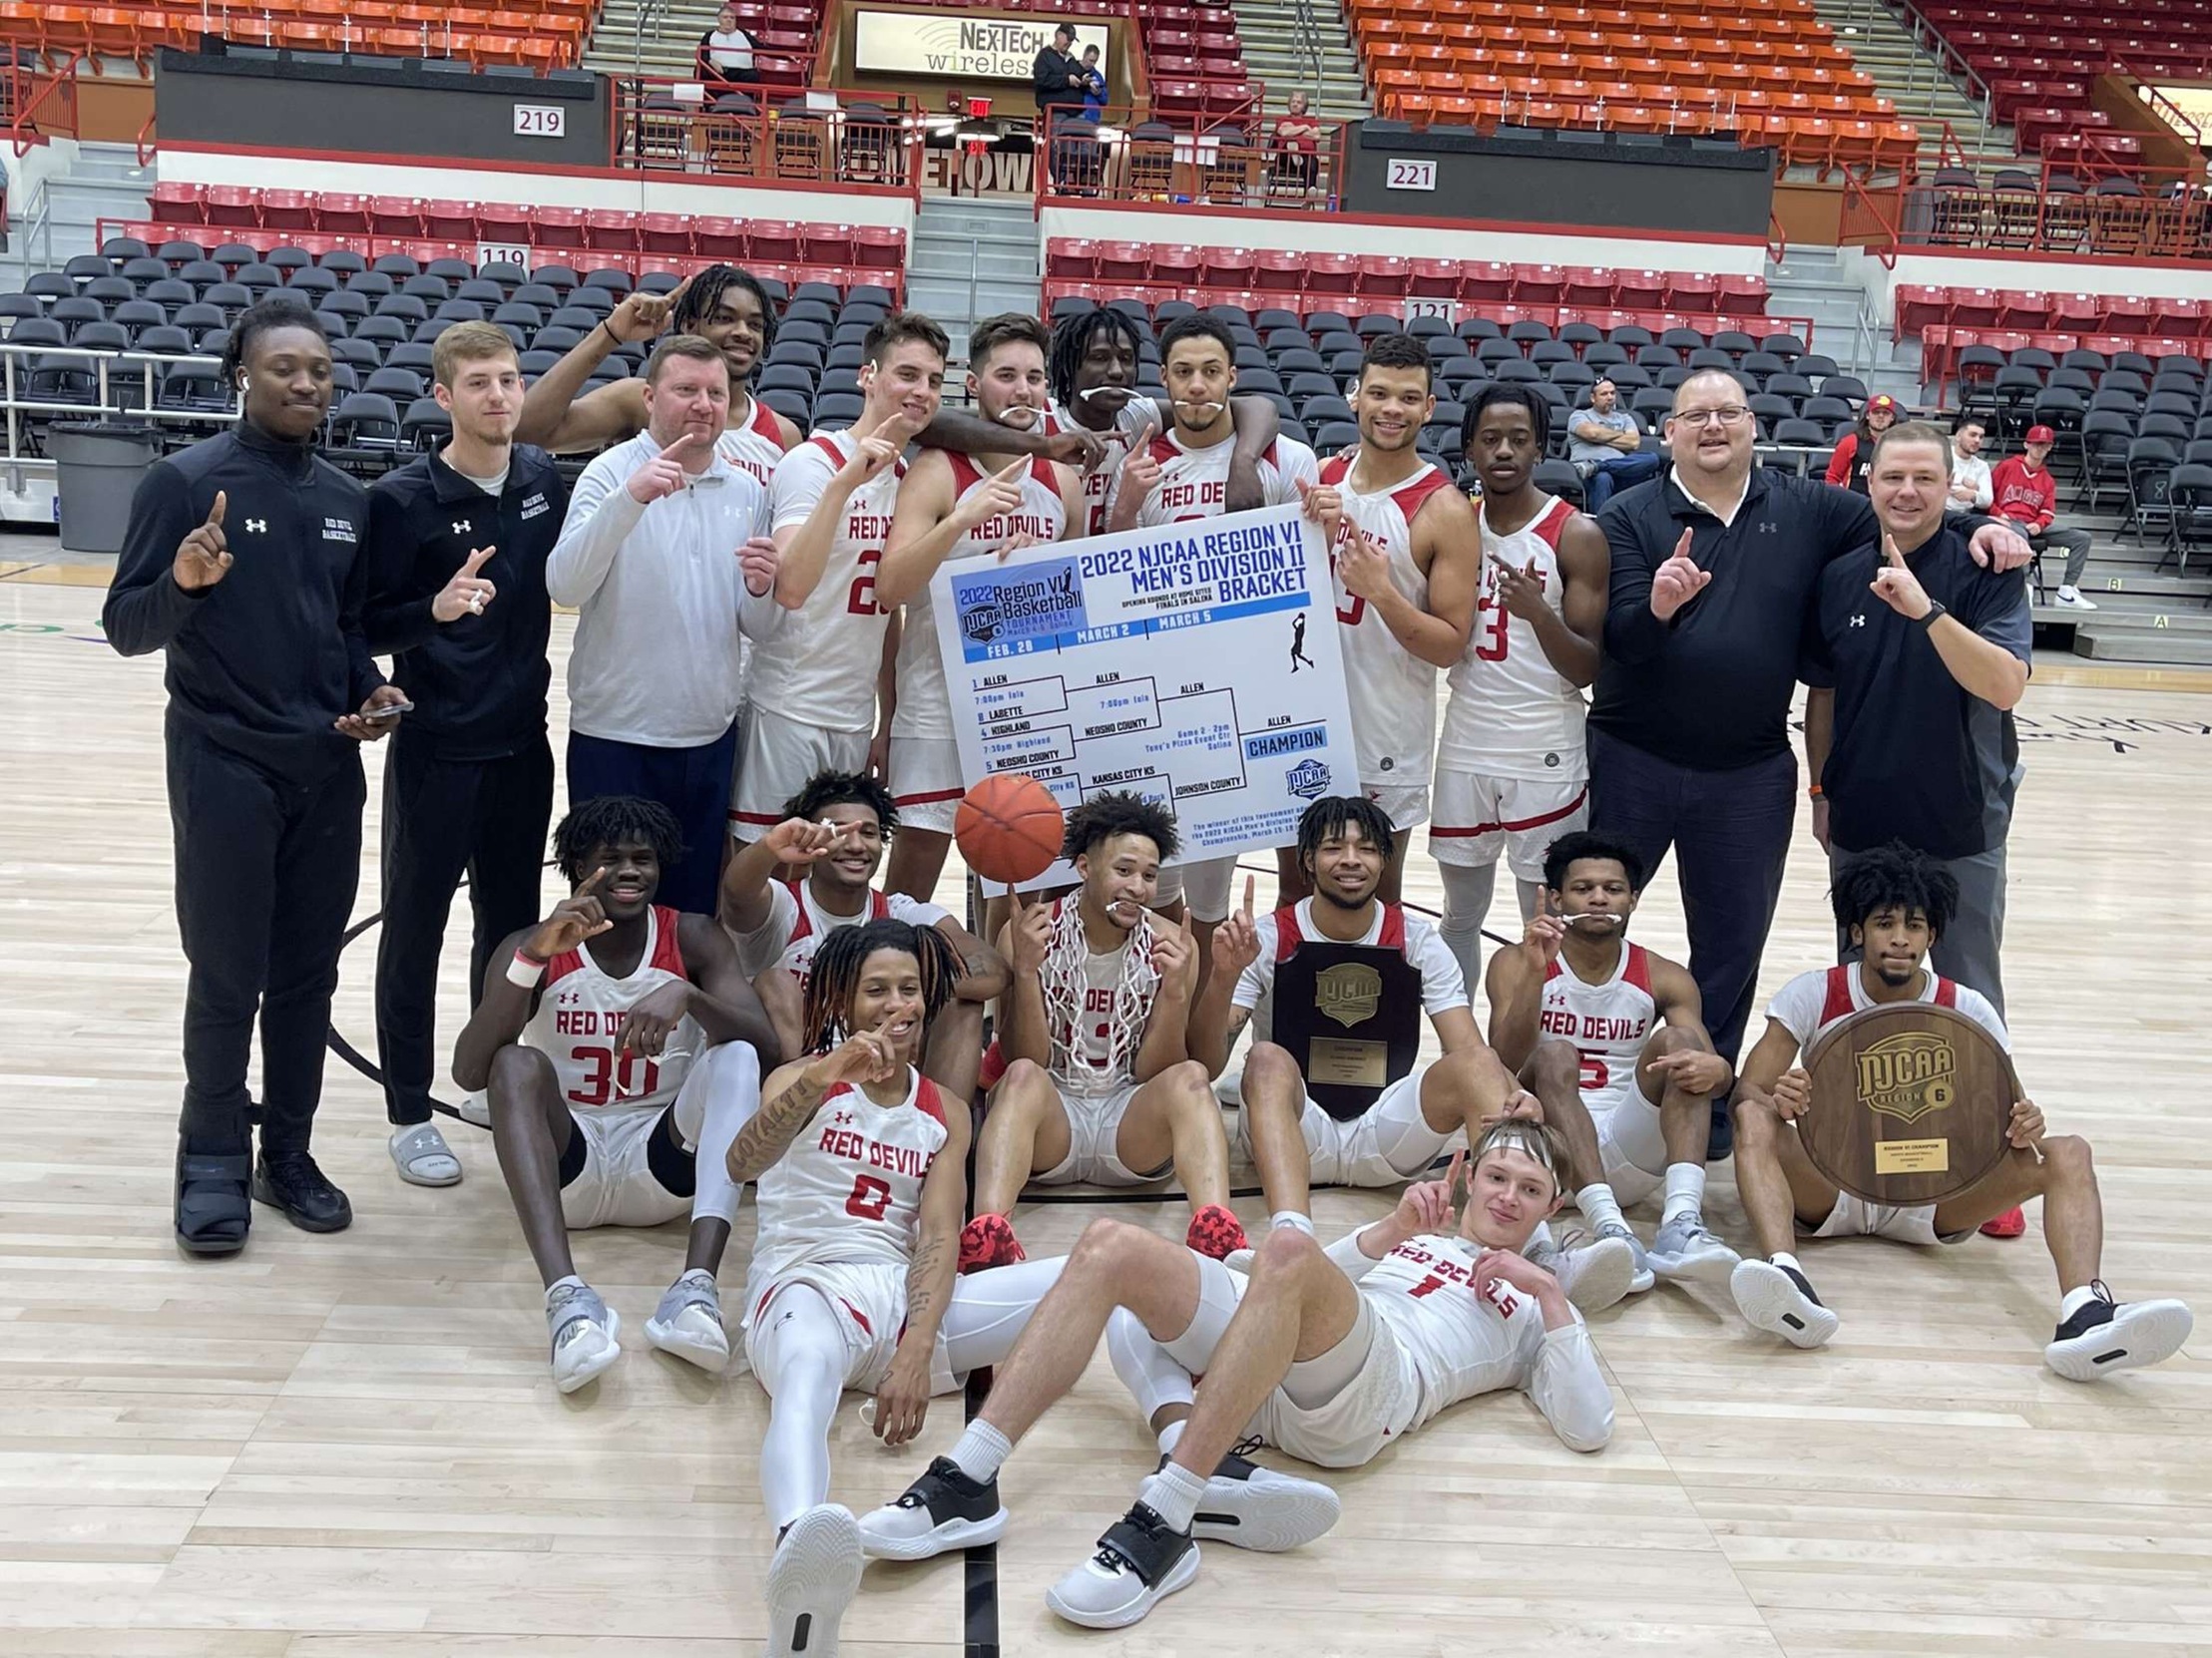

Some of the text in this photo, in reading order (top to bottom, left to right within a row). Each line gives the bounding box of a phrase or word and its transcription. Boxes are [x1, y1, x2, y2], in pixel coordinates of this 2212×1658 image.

[926, 52, 1035, 76] wireles
[519, 110, 560, 132] 219
[1393, 165, 1430, 186] 221
[483, 248, 525, 266] 119
[1412, 303, 1449, 319] 121
[1161, 485, 1194, 509] RED
[849, 516, 878, 540] RED
[1081, 549, 1134, 579] 2022
[1138, 538, 1200, 569] NJCAA
[1204, 526, 1275, 558] REGION
[1279, 520, 1302, 543] VI
[1130, 545, 1305, 595] MEN'S DIVISION II
[960, 585, 993, 606] 2022
[993, 582, 1045, 604] Region
[1218, 568, 1306, 603] BRACKET
[2109, 580, 2119, 590] B
[1003, 591, 1083, 620] Basketball
[963, 610, 1002, 633] NJCAA
[1005, 610, 1072, 629] TOURNAMENT
[1159, 611, 1212, 629] MARCH 5
[2156, 616, 2166, 627] A
[1077, 623, 1129, 643] MARCH 2
[988, 643, 1014, 658] FEB.
[973, 674, 1008, 688] 1 ALLEN
[1096, 671, 1119, 684] ALLEN
[1180, 682, 1204, 694] ALLEN
[989, 706, 1023, 719] LABETTE
[1267, 715, 1291, 727] ALLEN
[981, 721, 1031, 737] 4 HIGHLAND
[1085, 717, 1147, 737] NEOSHO COUNTY
[1249, 729, 1324, 756] CHAMPION
[986, 749, 1059, 770] 5 NEOSHO COUNTY
[1032, 766, 1052, 779] CITY
[1052, 765, 1063, 775] KS
[1092, 765, 1155, 784] KANSAS CITY KS
[1288, 766, 1327, 791] NJCAA
[1175, 776, 1241, 796] JOHNSON COUNTY
[556, 1010, 598, 1036] RED
[1540, 1010, 1646, 1040] RED DEVILS
[568, 1045, 660, 1106] 30
[1860, 1047, 1953, 1096] NJCAA
[1880, 1088, 1946, 1103] REGION 6
[819, 1127, 864, 1161] RED
[845, 1173, 893, 1221] 0
